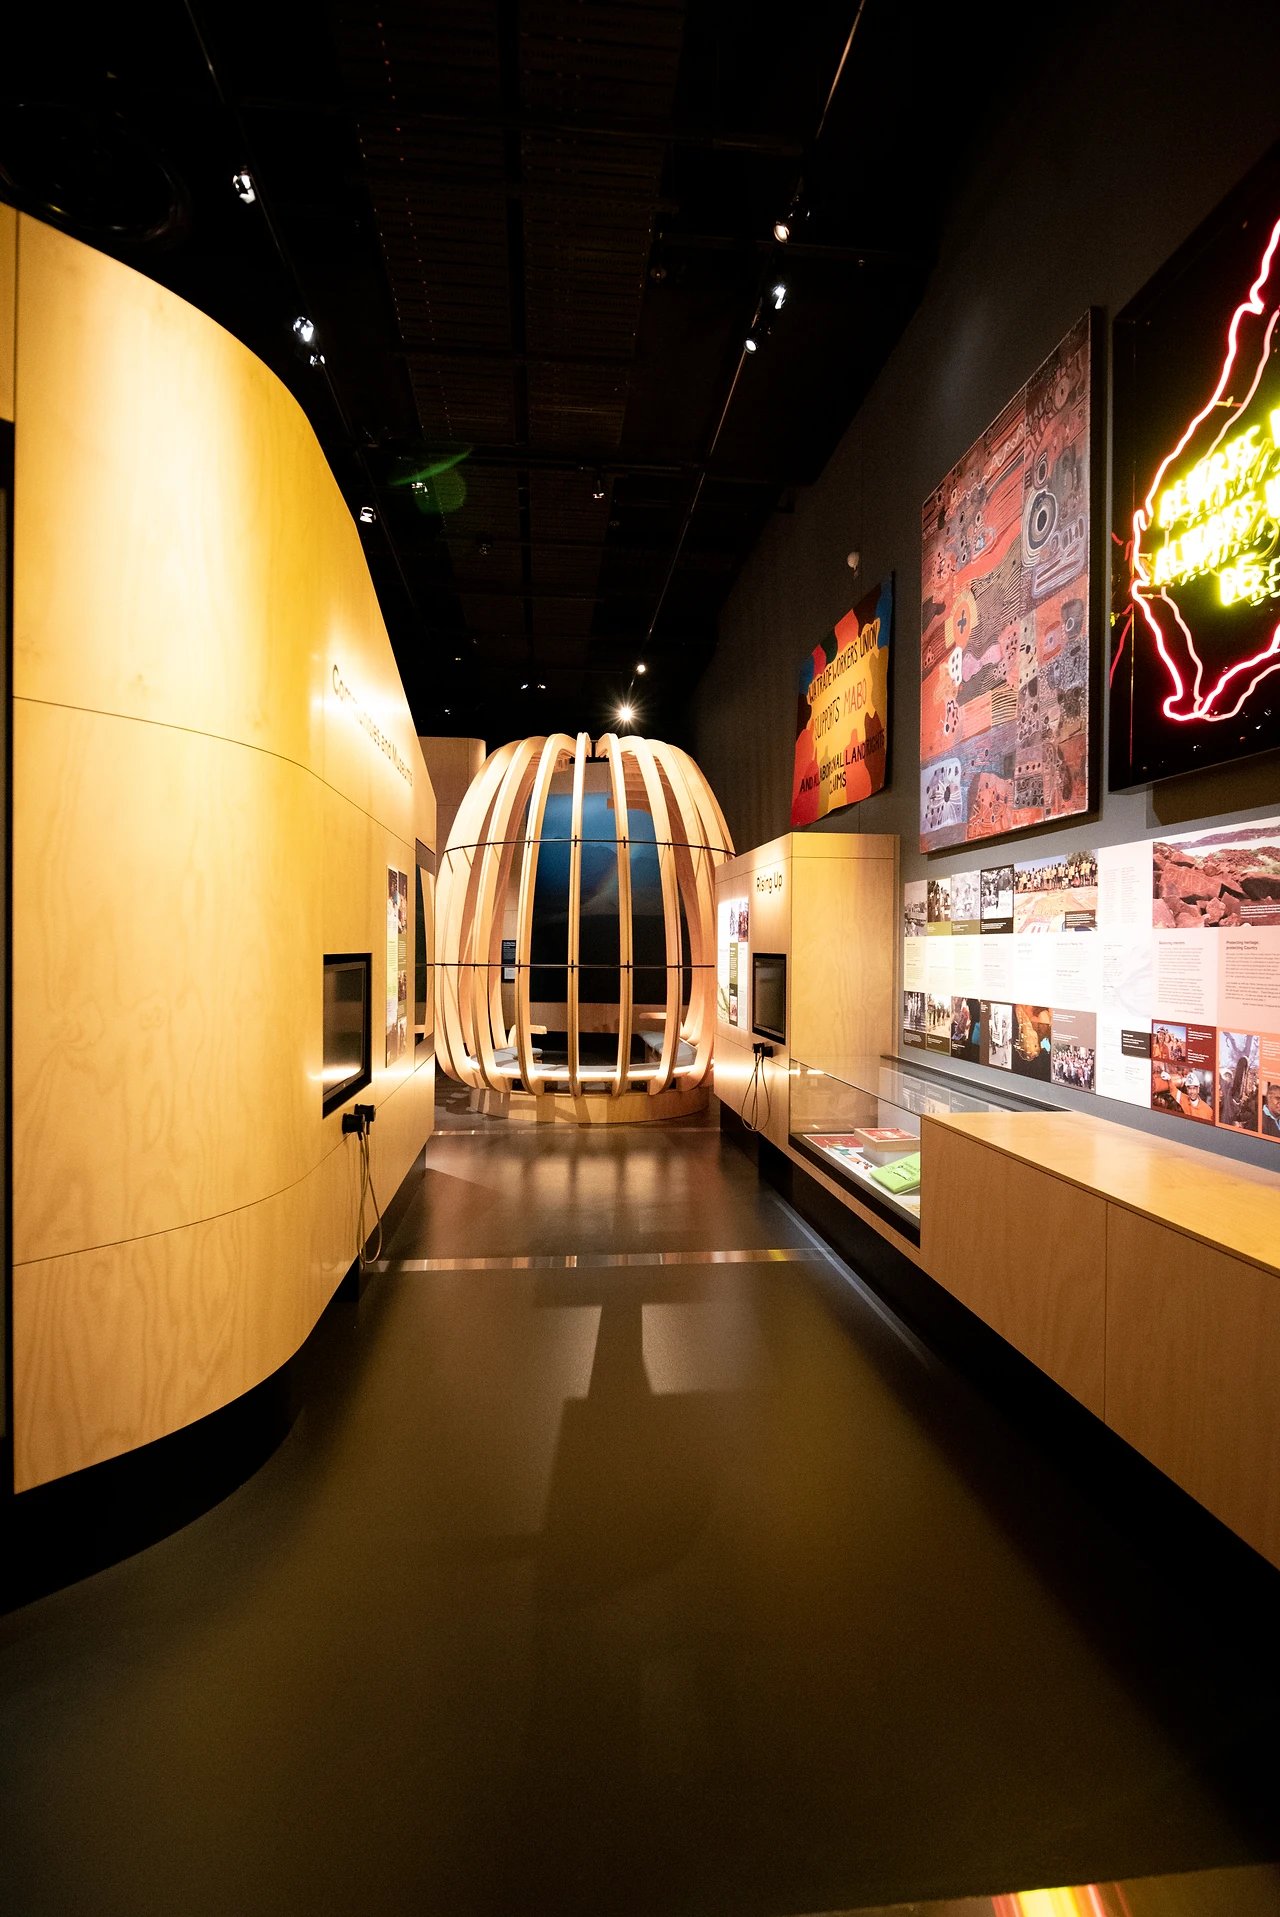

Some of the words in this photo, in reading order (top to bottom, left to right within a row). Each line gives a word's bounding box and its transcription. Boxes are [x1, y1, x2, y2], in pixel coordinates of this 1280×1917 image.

[832, 641, 858, 682] WORKERS
[859, 621, 878, 658] UNION
[815, 696, 841, 741] SUPPORTS
[843, 678, 867, 718] MABO
[800, 776, 813, 793] AND
[845, 743, 865, 766] LAND
[829, 771, 847, 795] CLAIMS
[756, 874, 773, 895] Rising
[774, 871, 783, 892] Up
